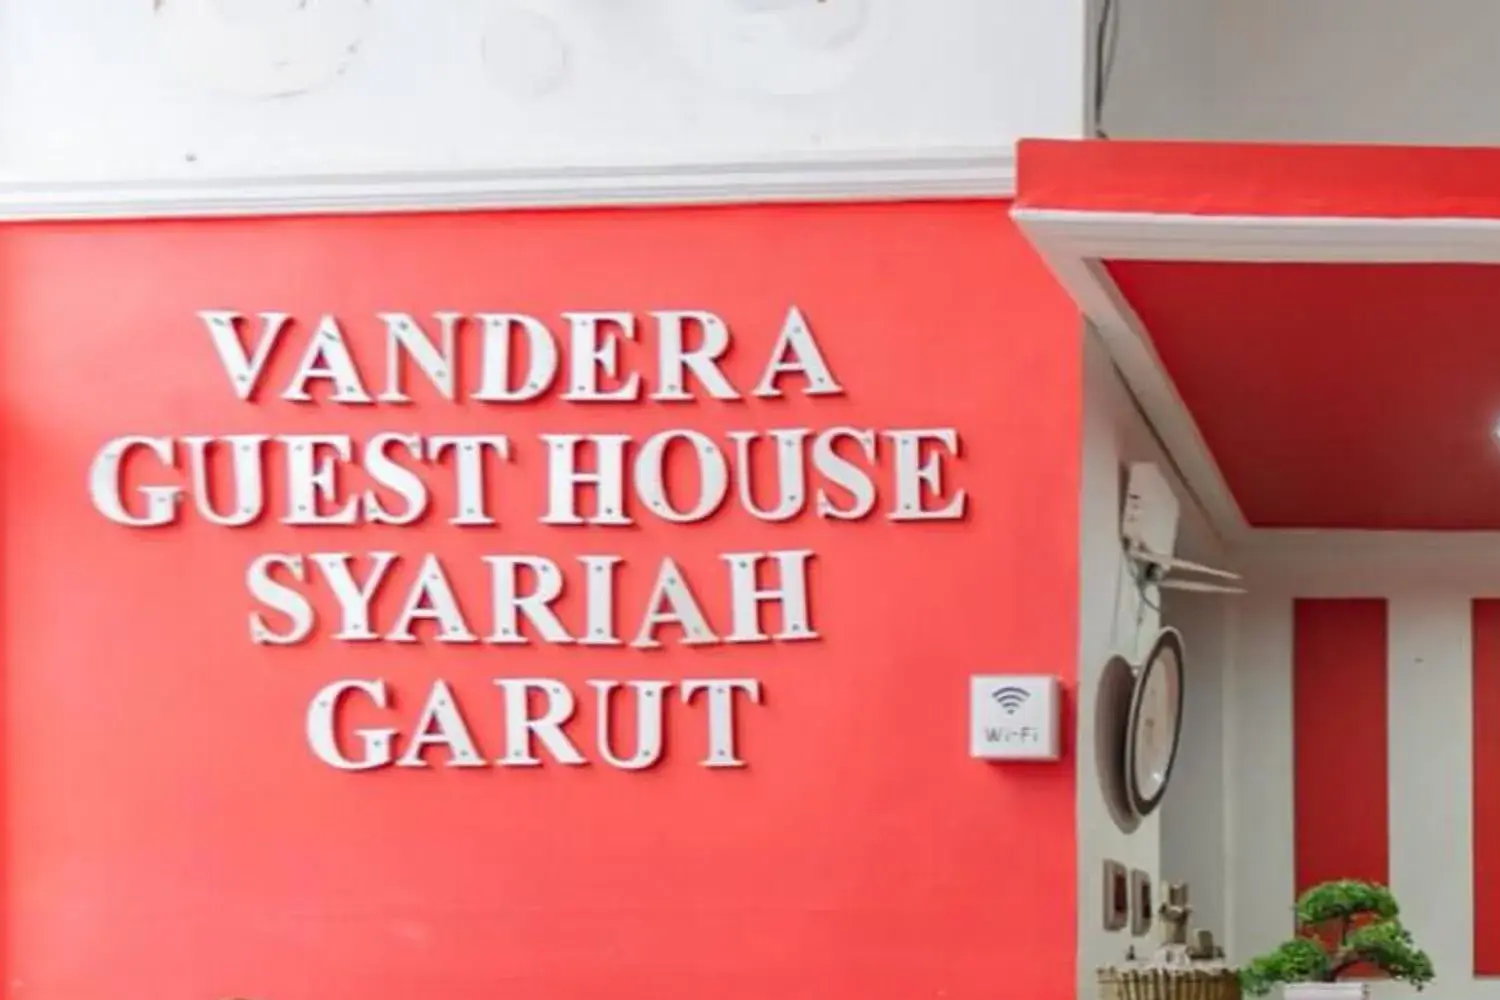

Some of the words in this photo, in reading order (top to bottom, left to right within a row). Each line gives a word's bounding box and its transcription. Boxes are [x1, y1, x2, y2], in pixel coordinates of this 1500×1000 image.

[198, 305, 845, 404] VANDERA
[89, 432, 508, 526] GUEST
[540, 427, 969, 526] HOUSE
[246, 548, 820, 649] SYARIAH
[306, 675, 762, 771] GARUT
[985, 726, 1039, 743] Wi-Fi
